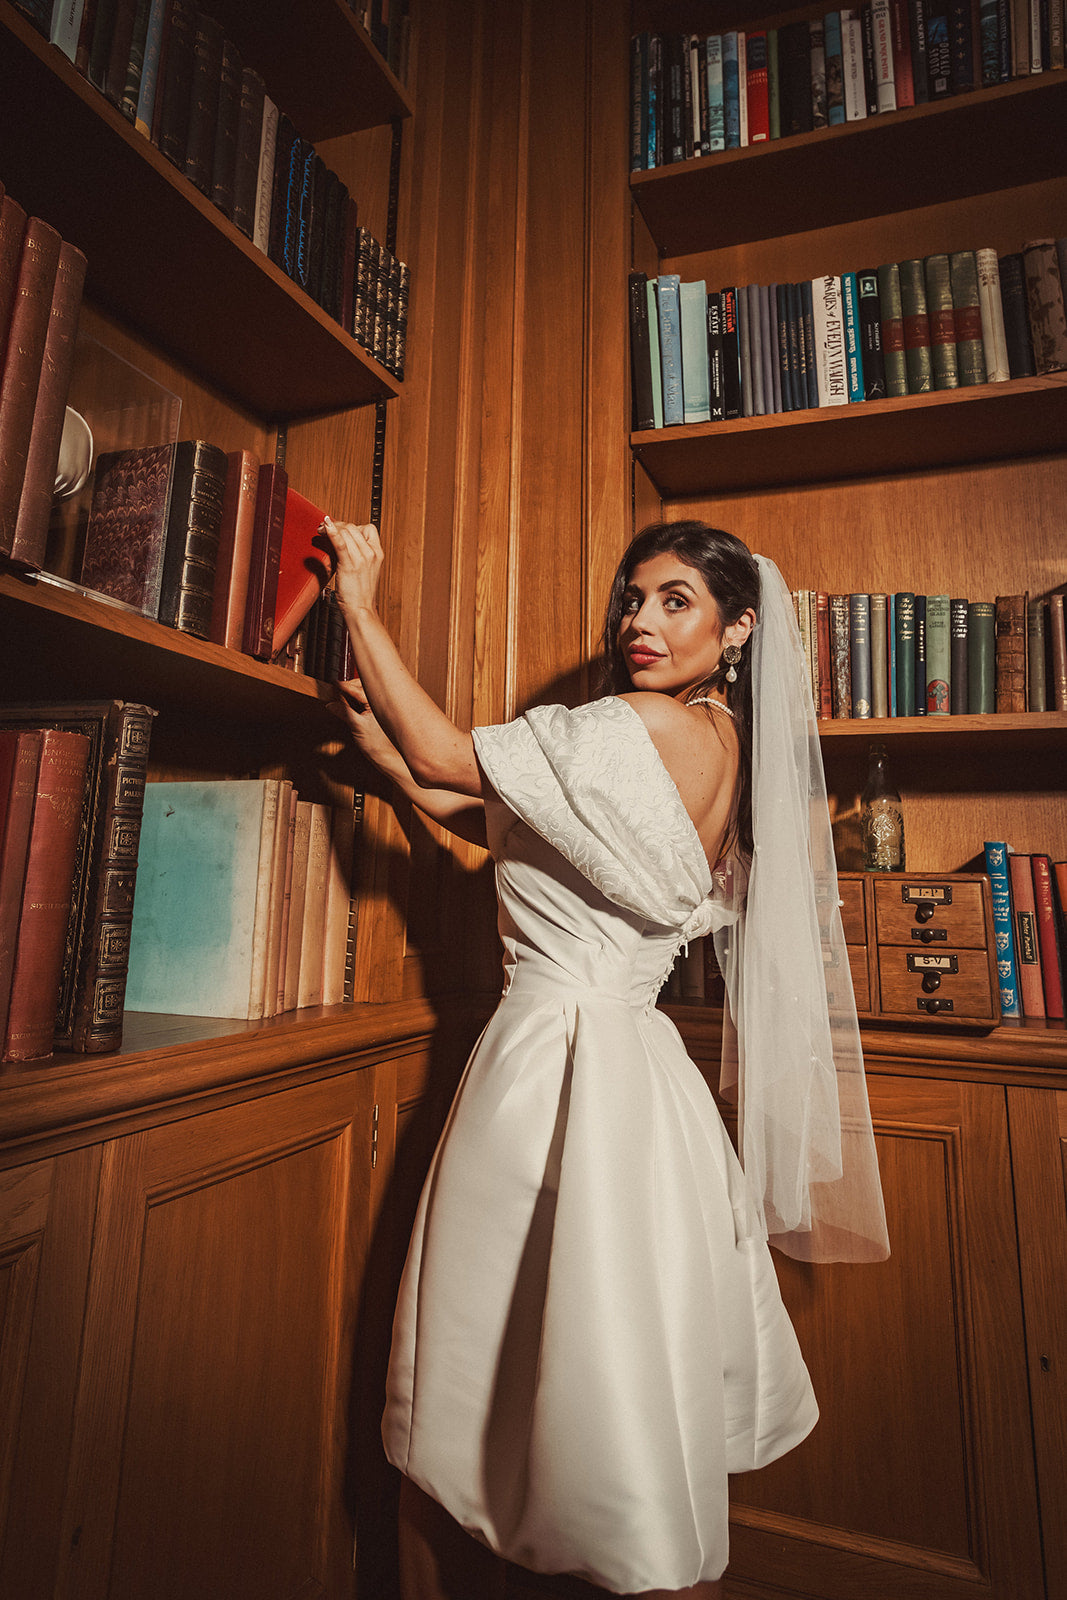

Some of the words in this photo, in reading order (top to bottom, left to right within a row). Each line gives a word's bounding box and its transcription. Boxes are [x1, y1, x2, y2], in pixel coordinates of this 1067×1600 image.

[929, 48, 940, 76] SPOTO
[939, 43, 951, 76] DONALD
[845, 294, 853, 309] FRONT
[711, 305, 719, 335] ESTATE
[824, 320, 841, 358] EVELYN
[847, 328, 856, 354] SERVANTS
[828, 359, 844, 396] WAUGH
[923, 956, 942, 965] S-V
